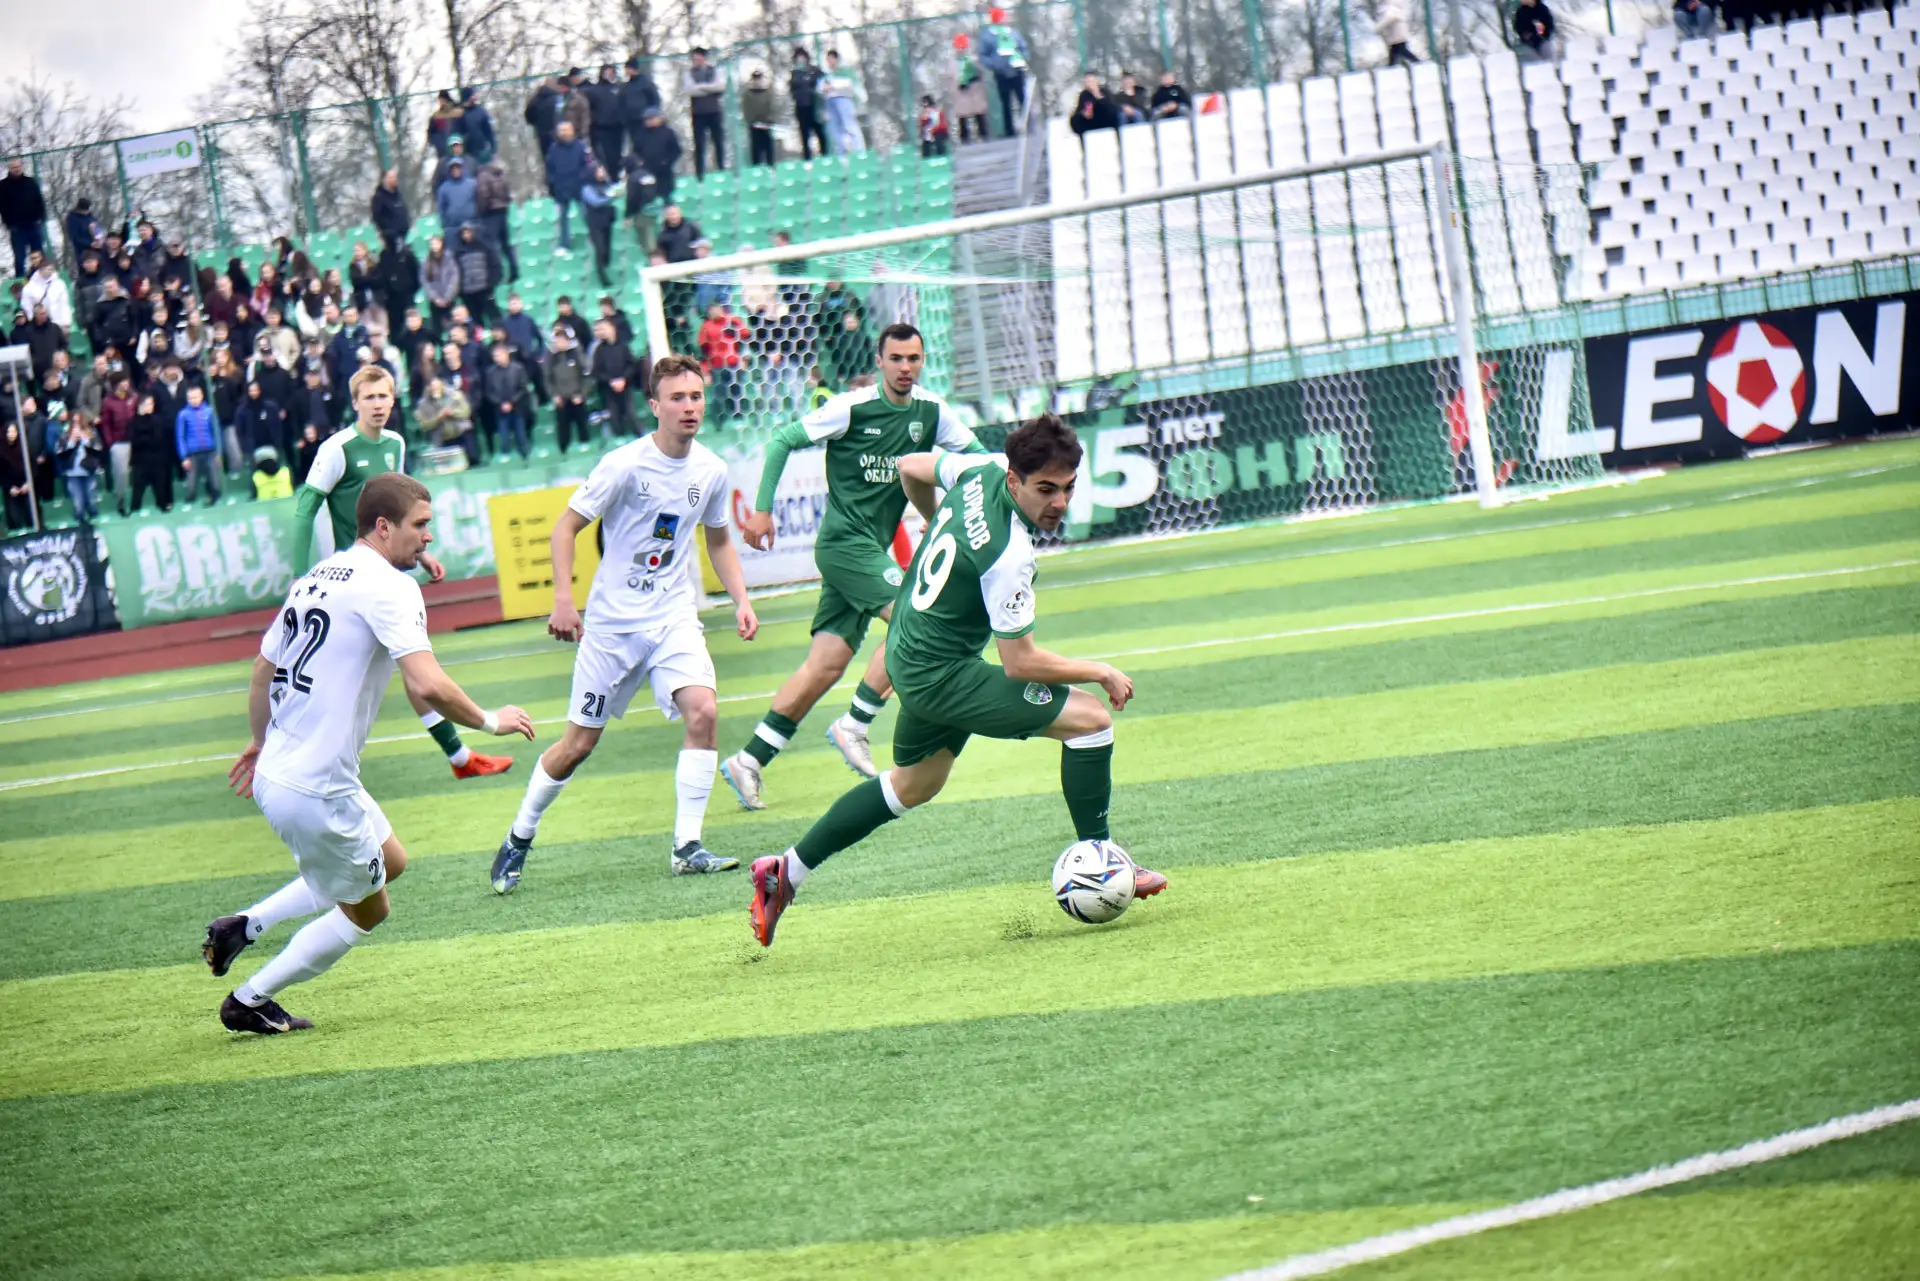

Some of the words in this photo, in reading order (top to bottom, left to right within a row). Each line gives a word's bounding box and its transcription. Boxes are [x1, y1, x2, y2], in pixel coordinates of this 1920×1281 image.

[1536, 300, 1907, 461] LEON
[859, 453, 902, 469] ОРЛОВС
[962, 473, 991, 551] БОРИСОВ
[911, 507, 957, 611] 19
[581, 691, 606, 718] 21
